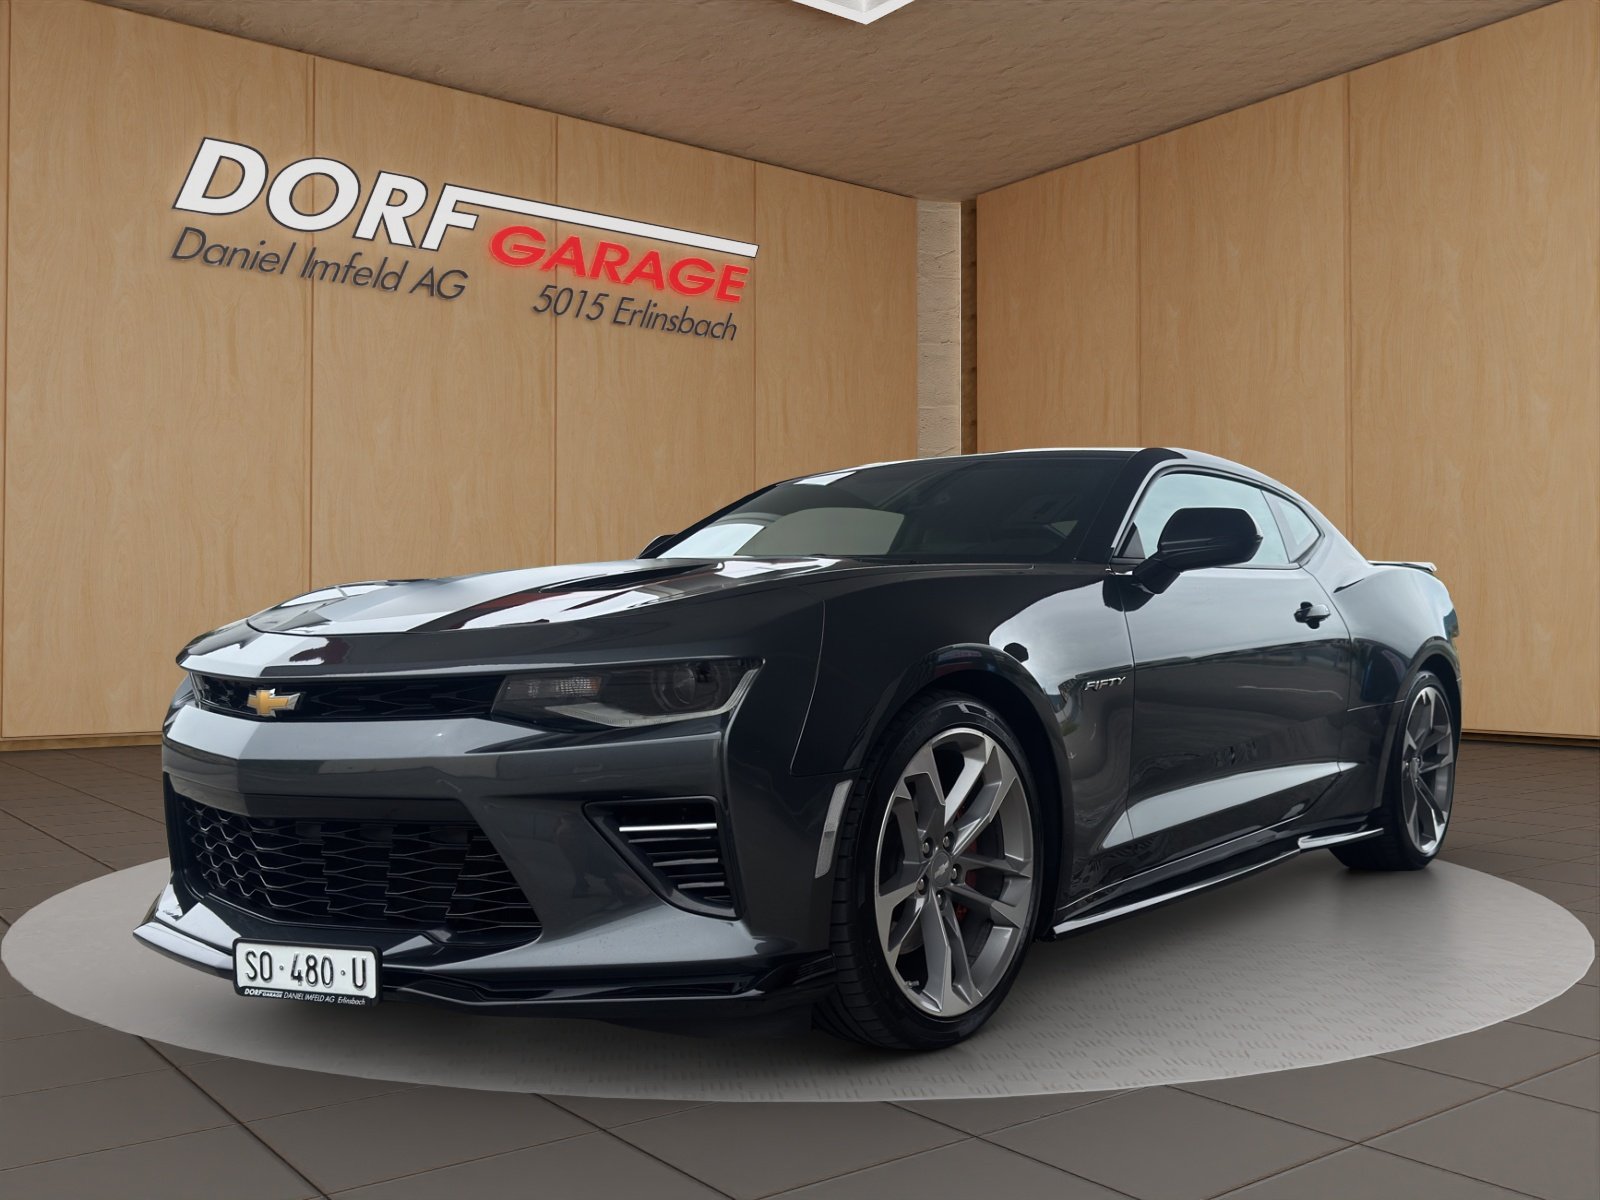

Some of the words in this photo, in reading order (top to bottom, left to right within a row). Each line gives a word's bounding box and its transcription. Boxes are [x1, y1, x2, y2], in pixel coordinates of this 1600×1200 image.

[172, 137, 479, 251] DORF
[489, 225, 750, 303] GARAGE
[171, 226, 297, 275] Daniel
[300, 247, 410, 292] Imfeld
[408, 266, 469, 300] AG
[532, 284, 610, 321] 5015
[611, 296, 738, 341] Erlinsbach
[1084, 676, 1126, 691] FIFTY
[325, 995, 335, 1003] AG
